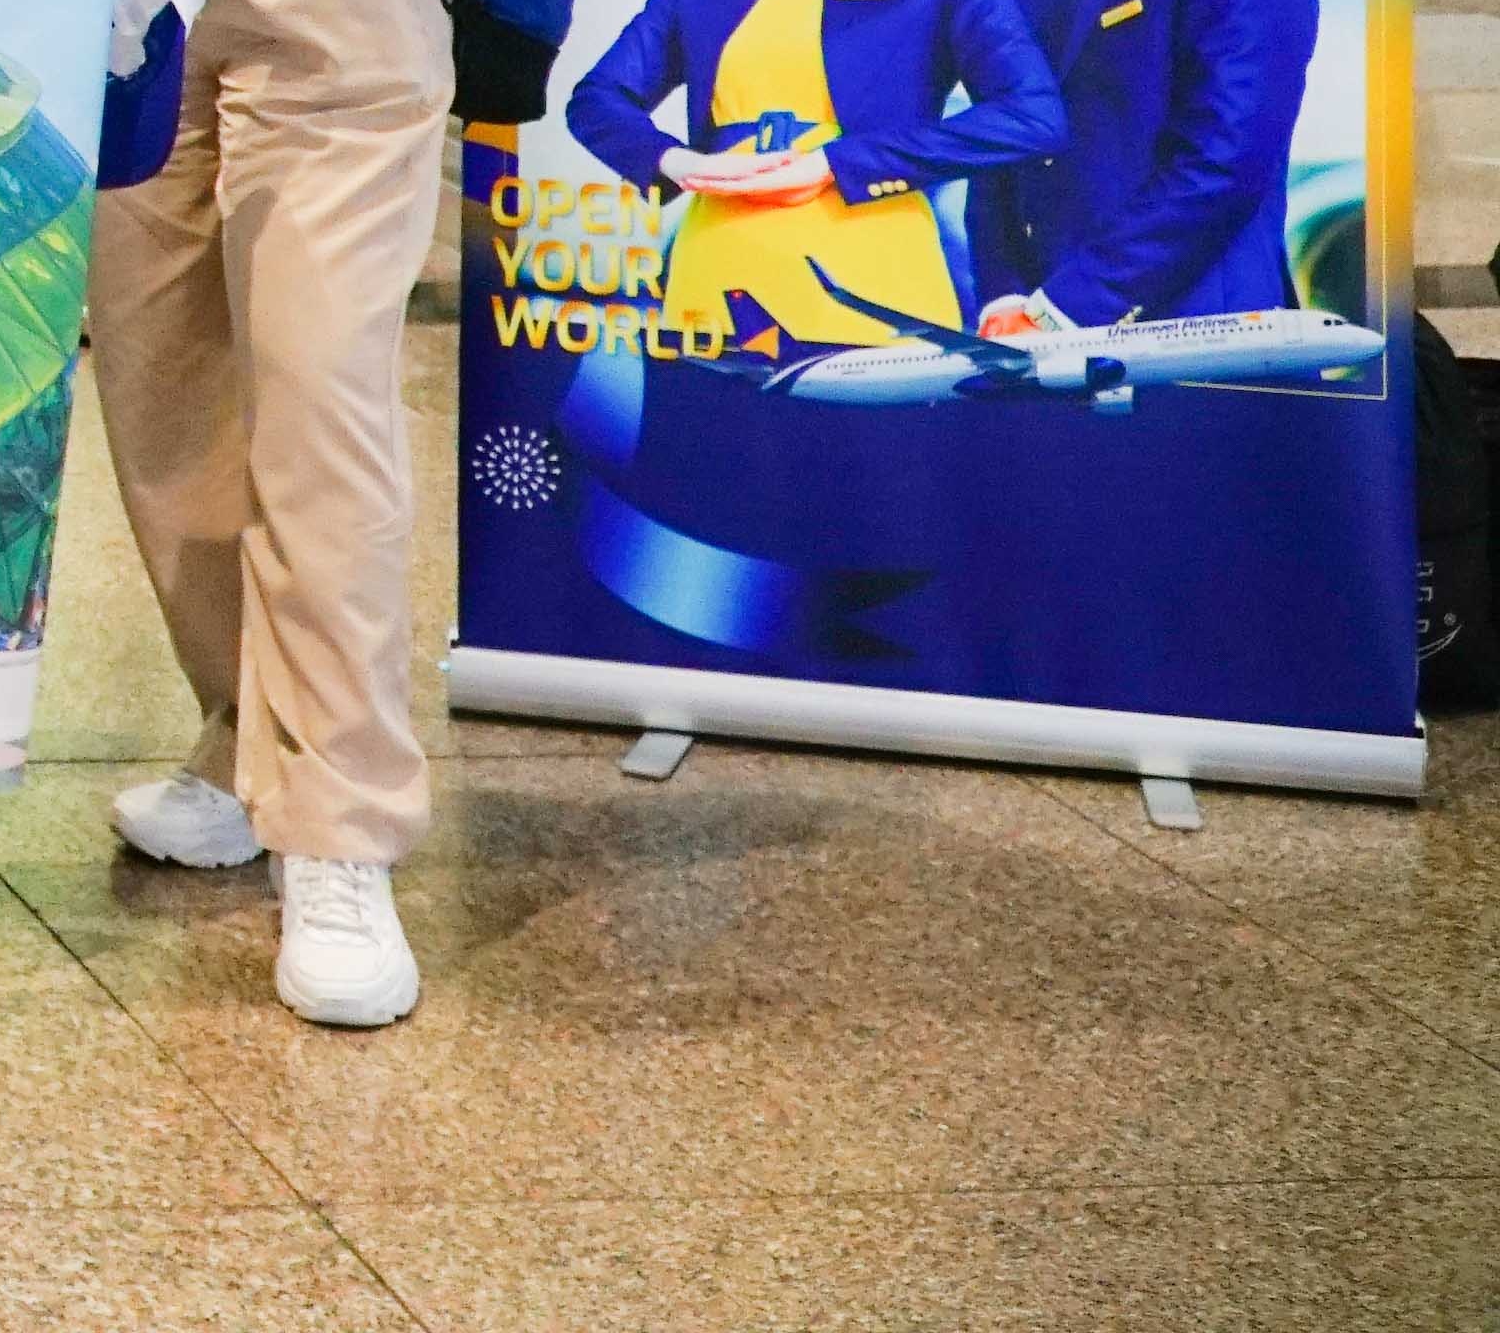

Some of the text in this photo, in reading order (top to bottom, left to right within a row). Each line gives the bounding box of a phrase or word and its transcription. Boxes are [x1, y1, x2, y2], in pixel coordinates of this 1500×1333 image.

[489, 174, 663, 239] OPEN
[492, 235, 664, 300] YOUR
[489, 294, 726, 362] WORLD
